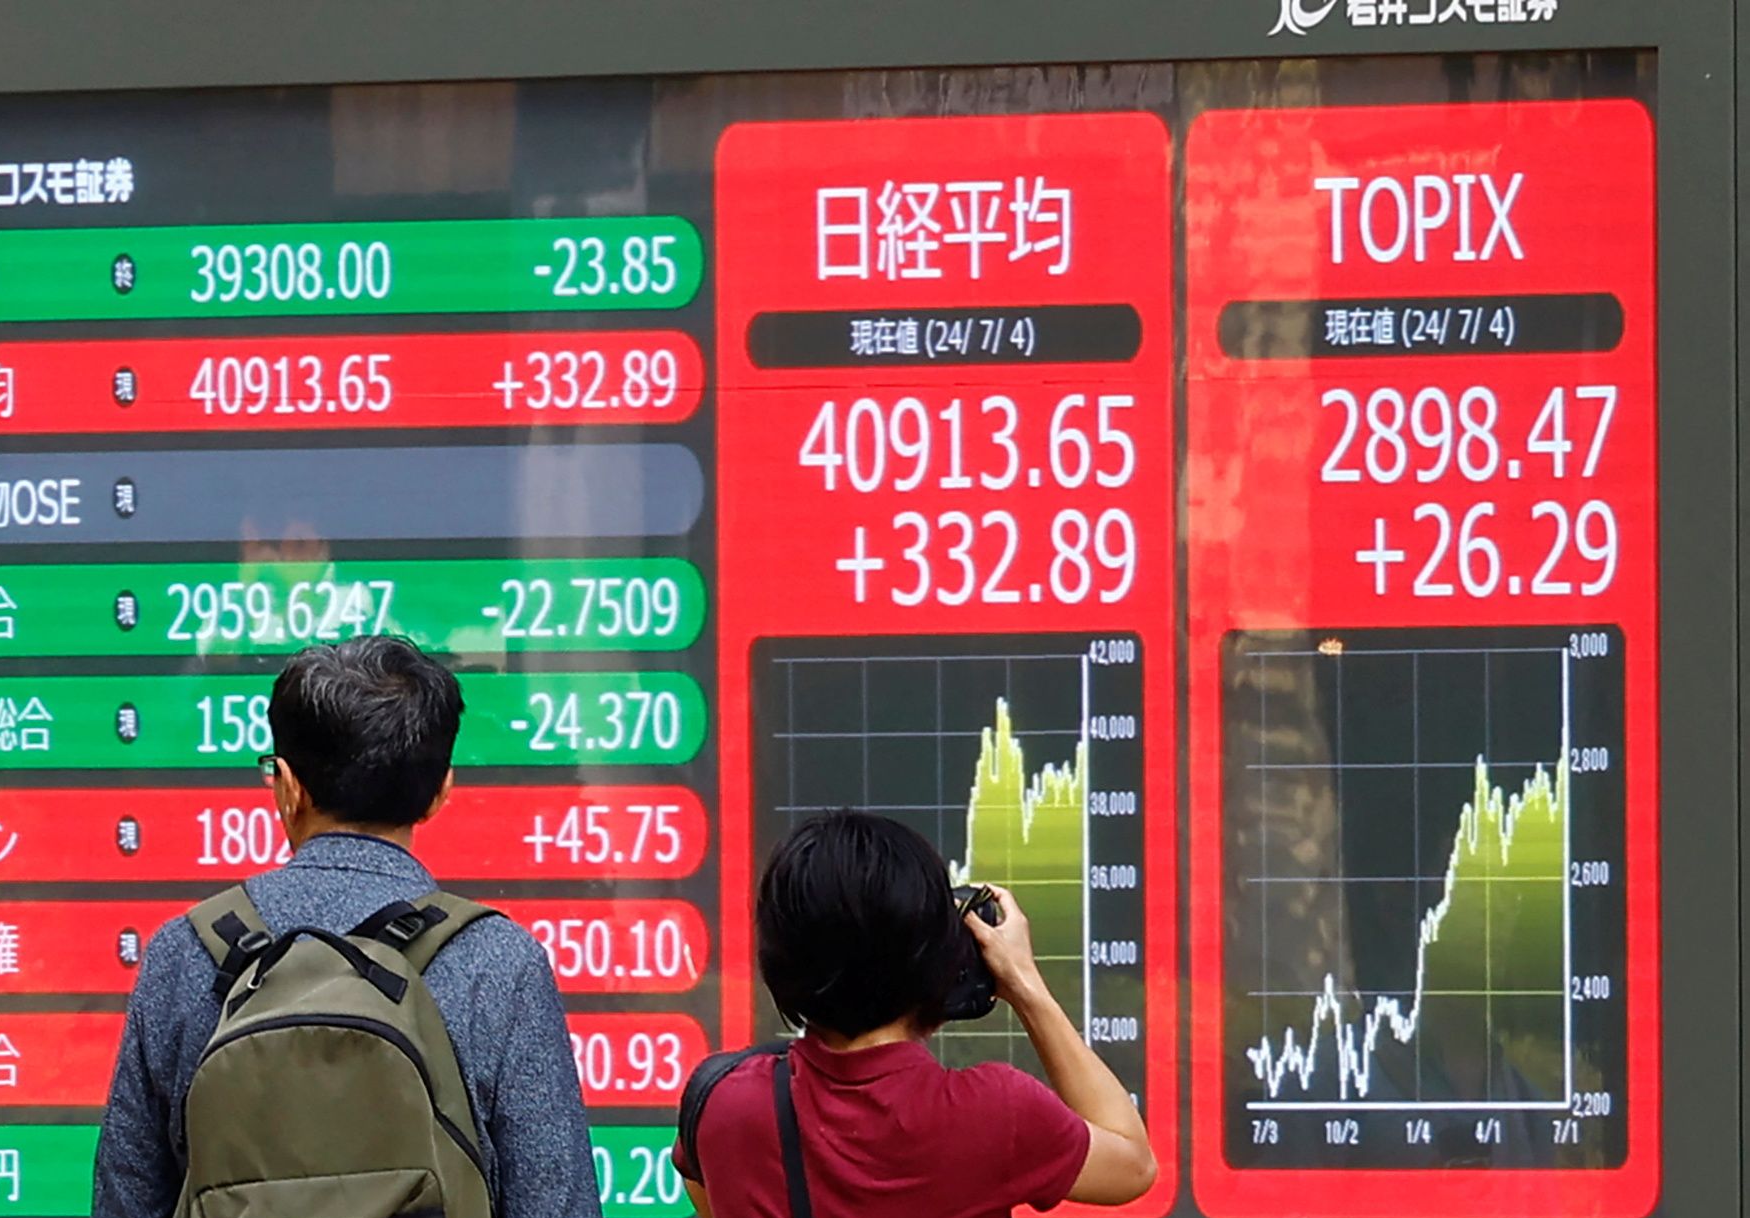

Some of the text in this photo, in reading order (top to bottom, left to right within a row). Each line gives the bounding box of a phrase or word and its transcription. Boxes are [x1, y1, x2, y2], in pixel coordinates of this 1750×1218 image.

[817, 176, 1071, 281] 日経平均
[1317, 174, 1523, 264] TOPIX
[191, 241, 391, 302] 39308.00
[534, 235, 676, 296] -23.85
[850, 317, 919, 355] 現在値
[1325, 307, 1395, 346] 現在値
[189, 354, 392, 414] 40913.65
[493, 349, 677, 409] +332.89
[799, 393, 1135, 493] 40913.65
[1321, 385, 1617, 484] 2898.47
[836, 508, 1136, 606] +332.89
[1356, 499, 1618, 598] +26.29
[167, 581, 395, 641] 2959.6247
[481, 577, 679, 637] -22.7509
[1088, 640, 1135, 664] 42,000
[1569, 632, 1608, 659] 3,000
[511, 690, 680, 751] -24.370
[1090, 716, 1135, 740] 40,000
[1570, 746, 1609, 773] 2,800
[1090, 791, 1136, 815] 38,000
[523, 805, 680, 863] +45.75
[1091, 866, 1136, 890] 36,000
[1570, 861, 1609, 887] 2,600
[1091, 941, 1137, 965] 34,000
[1571, 976, 1610, 1001] 2,400
[1091, 1017, 1138, 1041] 32,000
[1571, 1092, 1611, 1117] 2,200
[1251, 1118, 1578, 1145] 7/3 10/2 1/4 4/1 7/1
